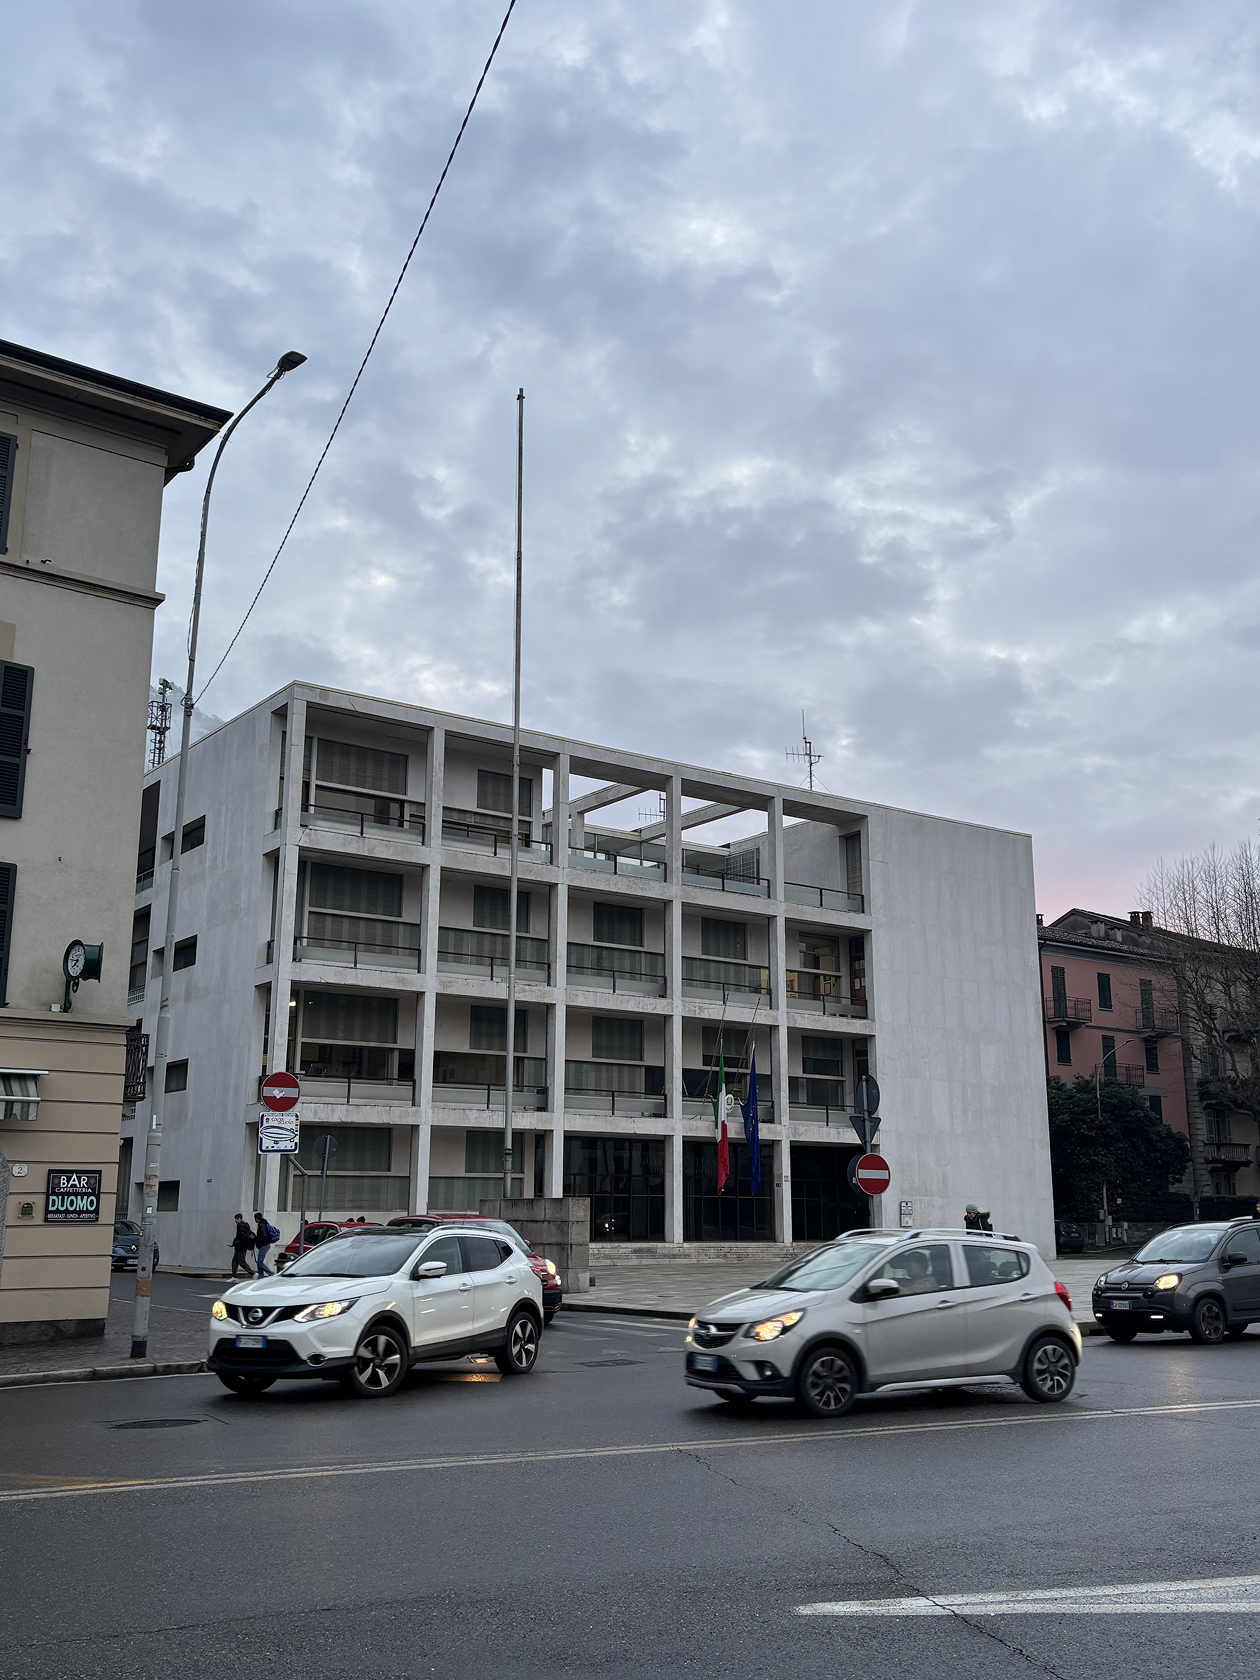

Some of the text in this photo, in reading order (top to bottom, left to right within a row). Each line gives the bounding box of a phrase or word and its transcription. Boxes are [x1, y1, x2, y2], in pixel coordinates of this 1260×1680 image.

[17, 1166, 23, 1175] 2
[60, 1173, 88, 1188] BAR
[48, 1195, 97, 1211] DUOMO
